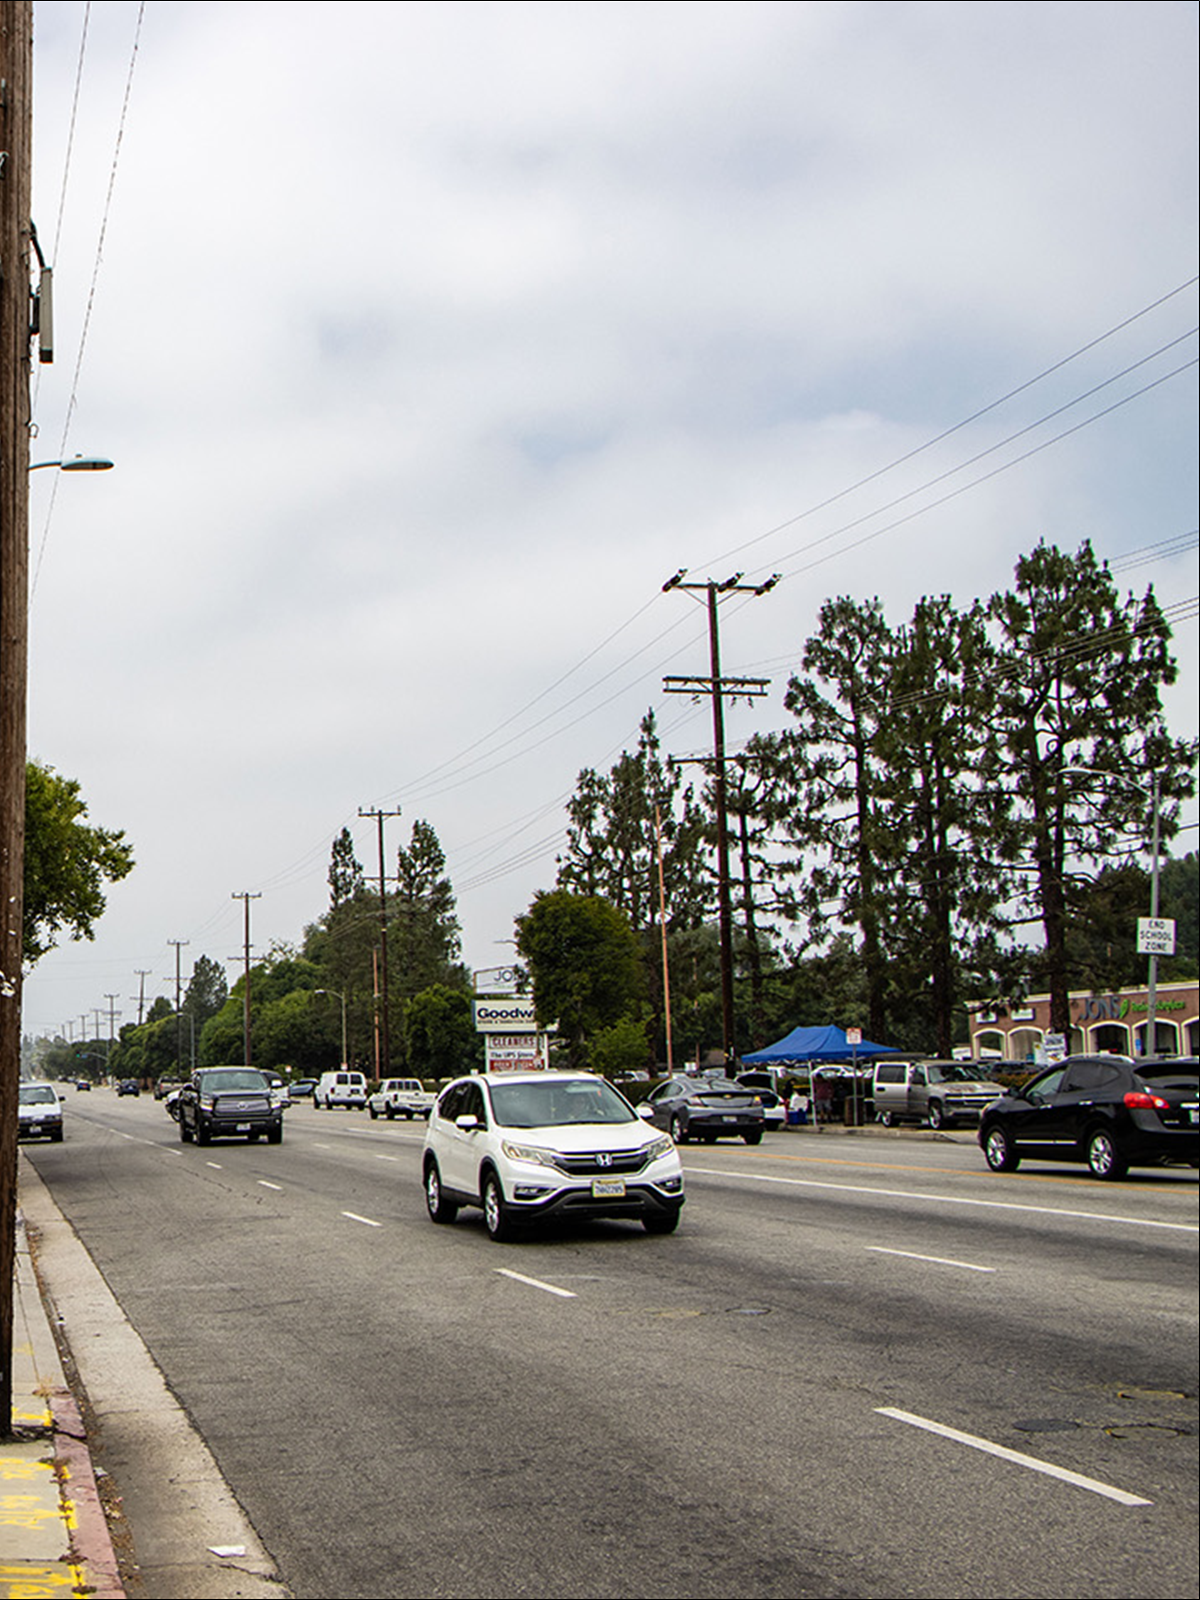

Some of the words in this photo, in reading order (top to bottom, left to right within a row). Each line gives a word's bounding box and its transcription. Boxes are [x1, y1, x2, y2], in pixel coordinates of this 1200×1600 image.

[1148, 919, 1165, 930] END
[1140, 930, 1172, 942] SCHOOL
[1145, 941, 1167, 951] ZONE
[477, 1007, 534, 1020] Goodw
[1080, 996, 1121, 1020] JONS
